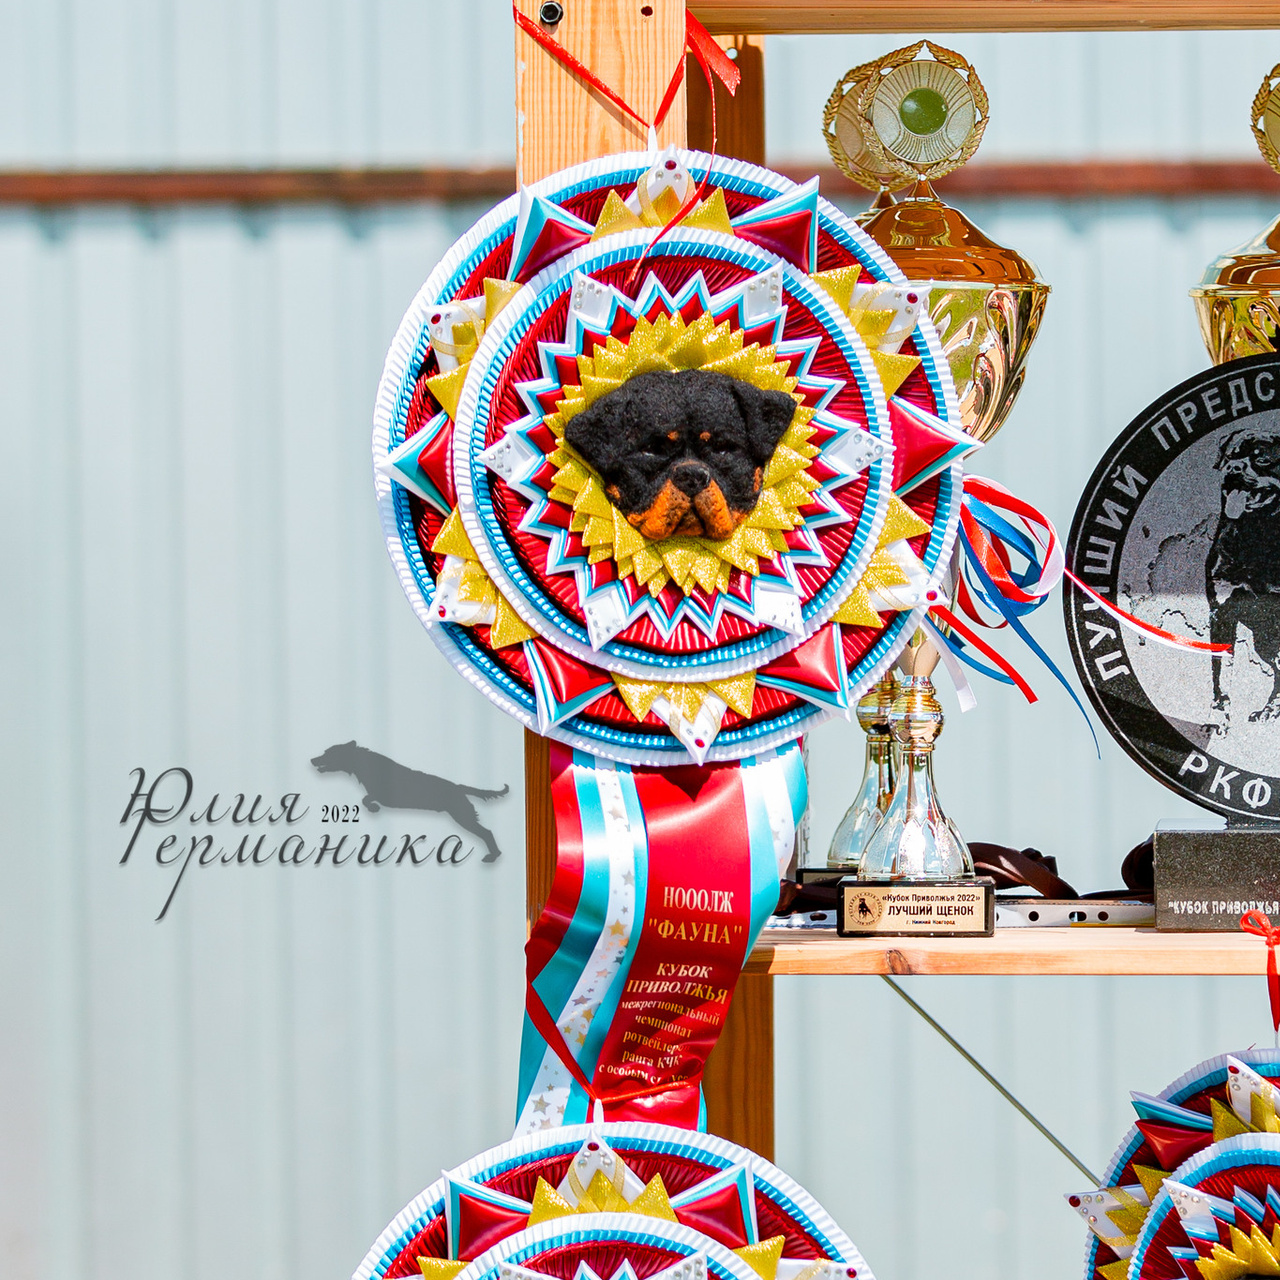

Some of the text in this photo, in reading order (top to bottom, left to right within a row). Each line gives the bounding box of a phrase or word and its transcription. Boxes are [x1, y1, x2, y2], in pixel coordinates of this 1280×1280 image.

[663, 886, 734, 914] НОООЛЖ
[882, 894, 981, 903] «Кубок Приволжья 2022»
[1168, 901, 1209, 915] "КУБОК
[1212, 901, 1280, 915] ПРИВОЛЖЬЯ
[887, 904, 974, 918] ЛУЧШИЙ ЩЕНОК
[649, 918, 743, 945] "ФАУНА"
[656, 962, 713, 979] КУБОК
[626, 979, 728, 1005] ПРИВОЛЖЬЯ
[621, 1000, 720, 1026] межрегиональный
[635, 1015, 693, 1039] чемпионат
[622, 1050, 683, 1069] ранга КЧК
